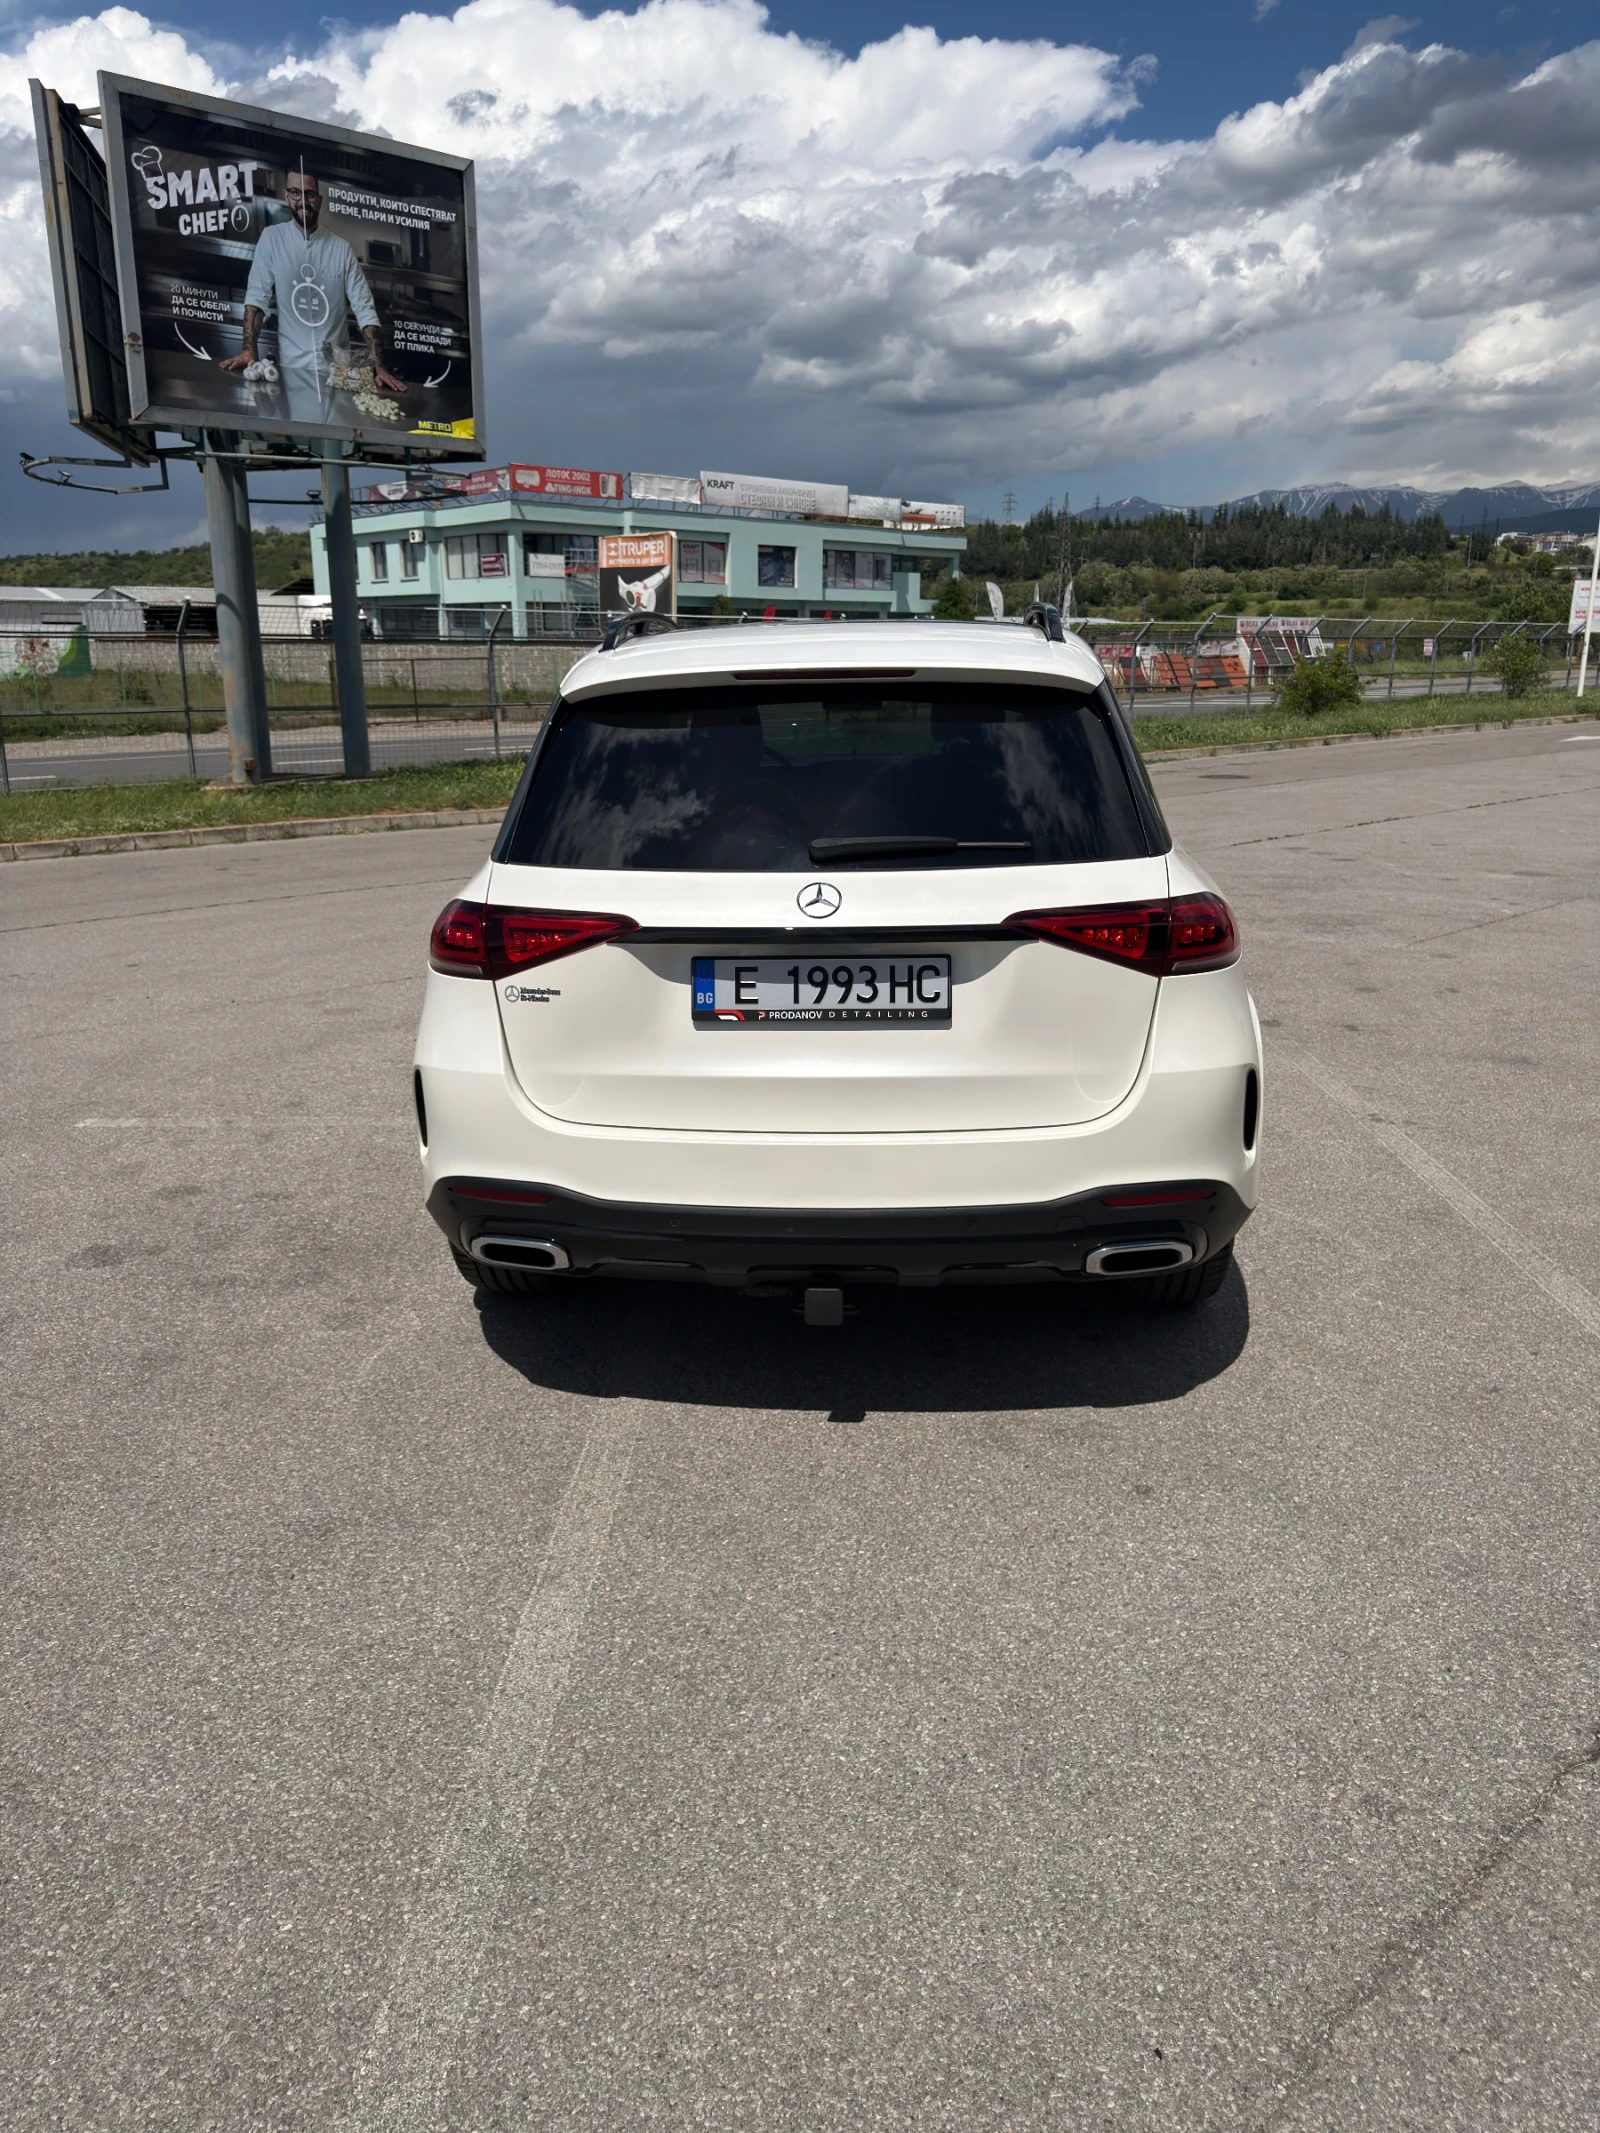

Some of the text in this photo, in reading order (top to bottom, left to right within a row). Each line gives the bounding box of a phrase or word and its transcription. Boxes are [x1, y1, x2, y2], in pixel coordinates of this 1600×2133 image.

[146, 162, 257, 210] SMART
[328, 187, 456, 222] ПРОДУКТИ, КОИТО СПЕСТЯВАТ
[179, 209, 229, 236] CHEF
[329, 202, 430, 231] ВРЕМЕ, ПАРИ И УСИЛИЯ
[170, 283, 218, 300] 20 МИНУТИ
[171, 295, 231, 312] ДА СЕ ОБЕЛИ
[172, 306, 224, 322] И ПОЧИСТИ
[393, 320, 440, 334] 10 СЕКУНДИ
[393, 330, 452, 346] ДА СЕ ИЗВАДИ
[394, 340, 435, 354] ОТ ПЛИКА
[417, 420, 452, 432] METRO
[706, 479, 735, 490] KRAFT
[620, 540, 665, 556] TRUPER
[735, 964, 941, 1005] E 1993 HC
[697, 992, 714, 1004] BG
[769, 1011, 823, 1020] PRODANOV
